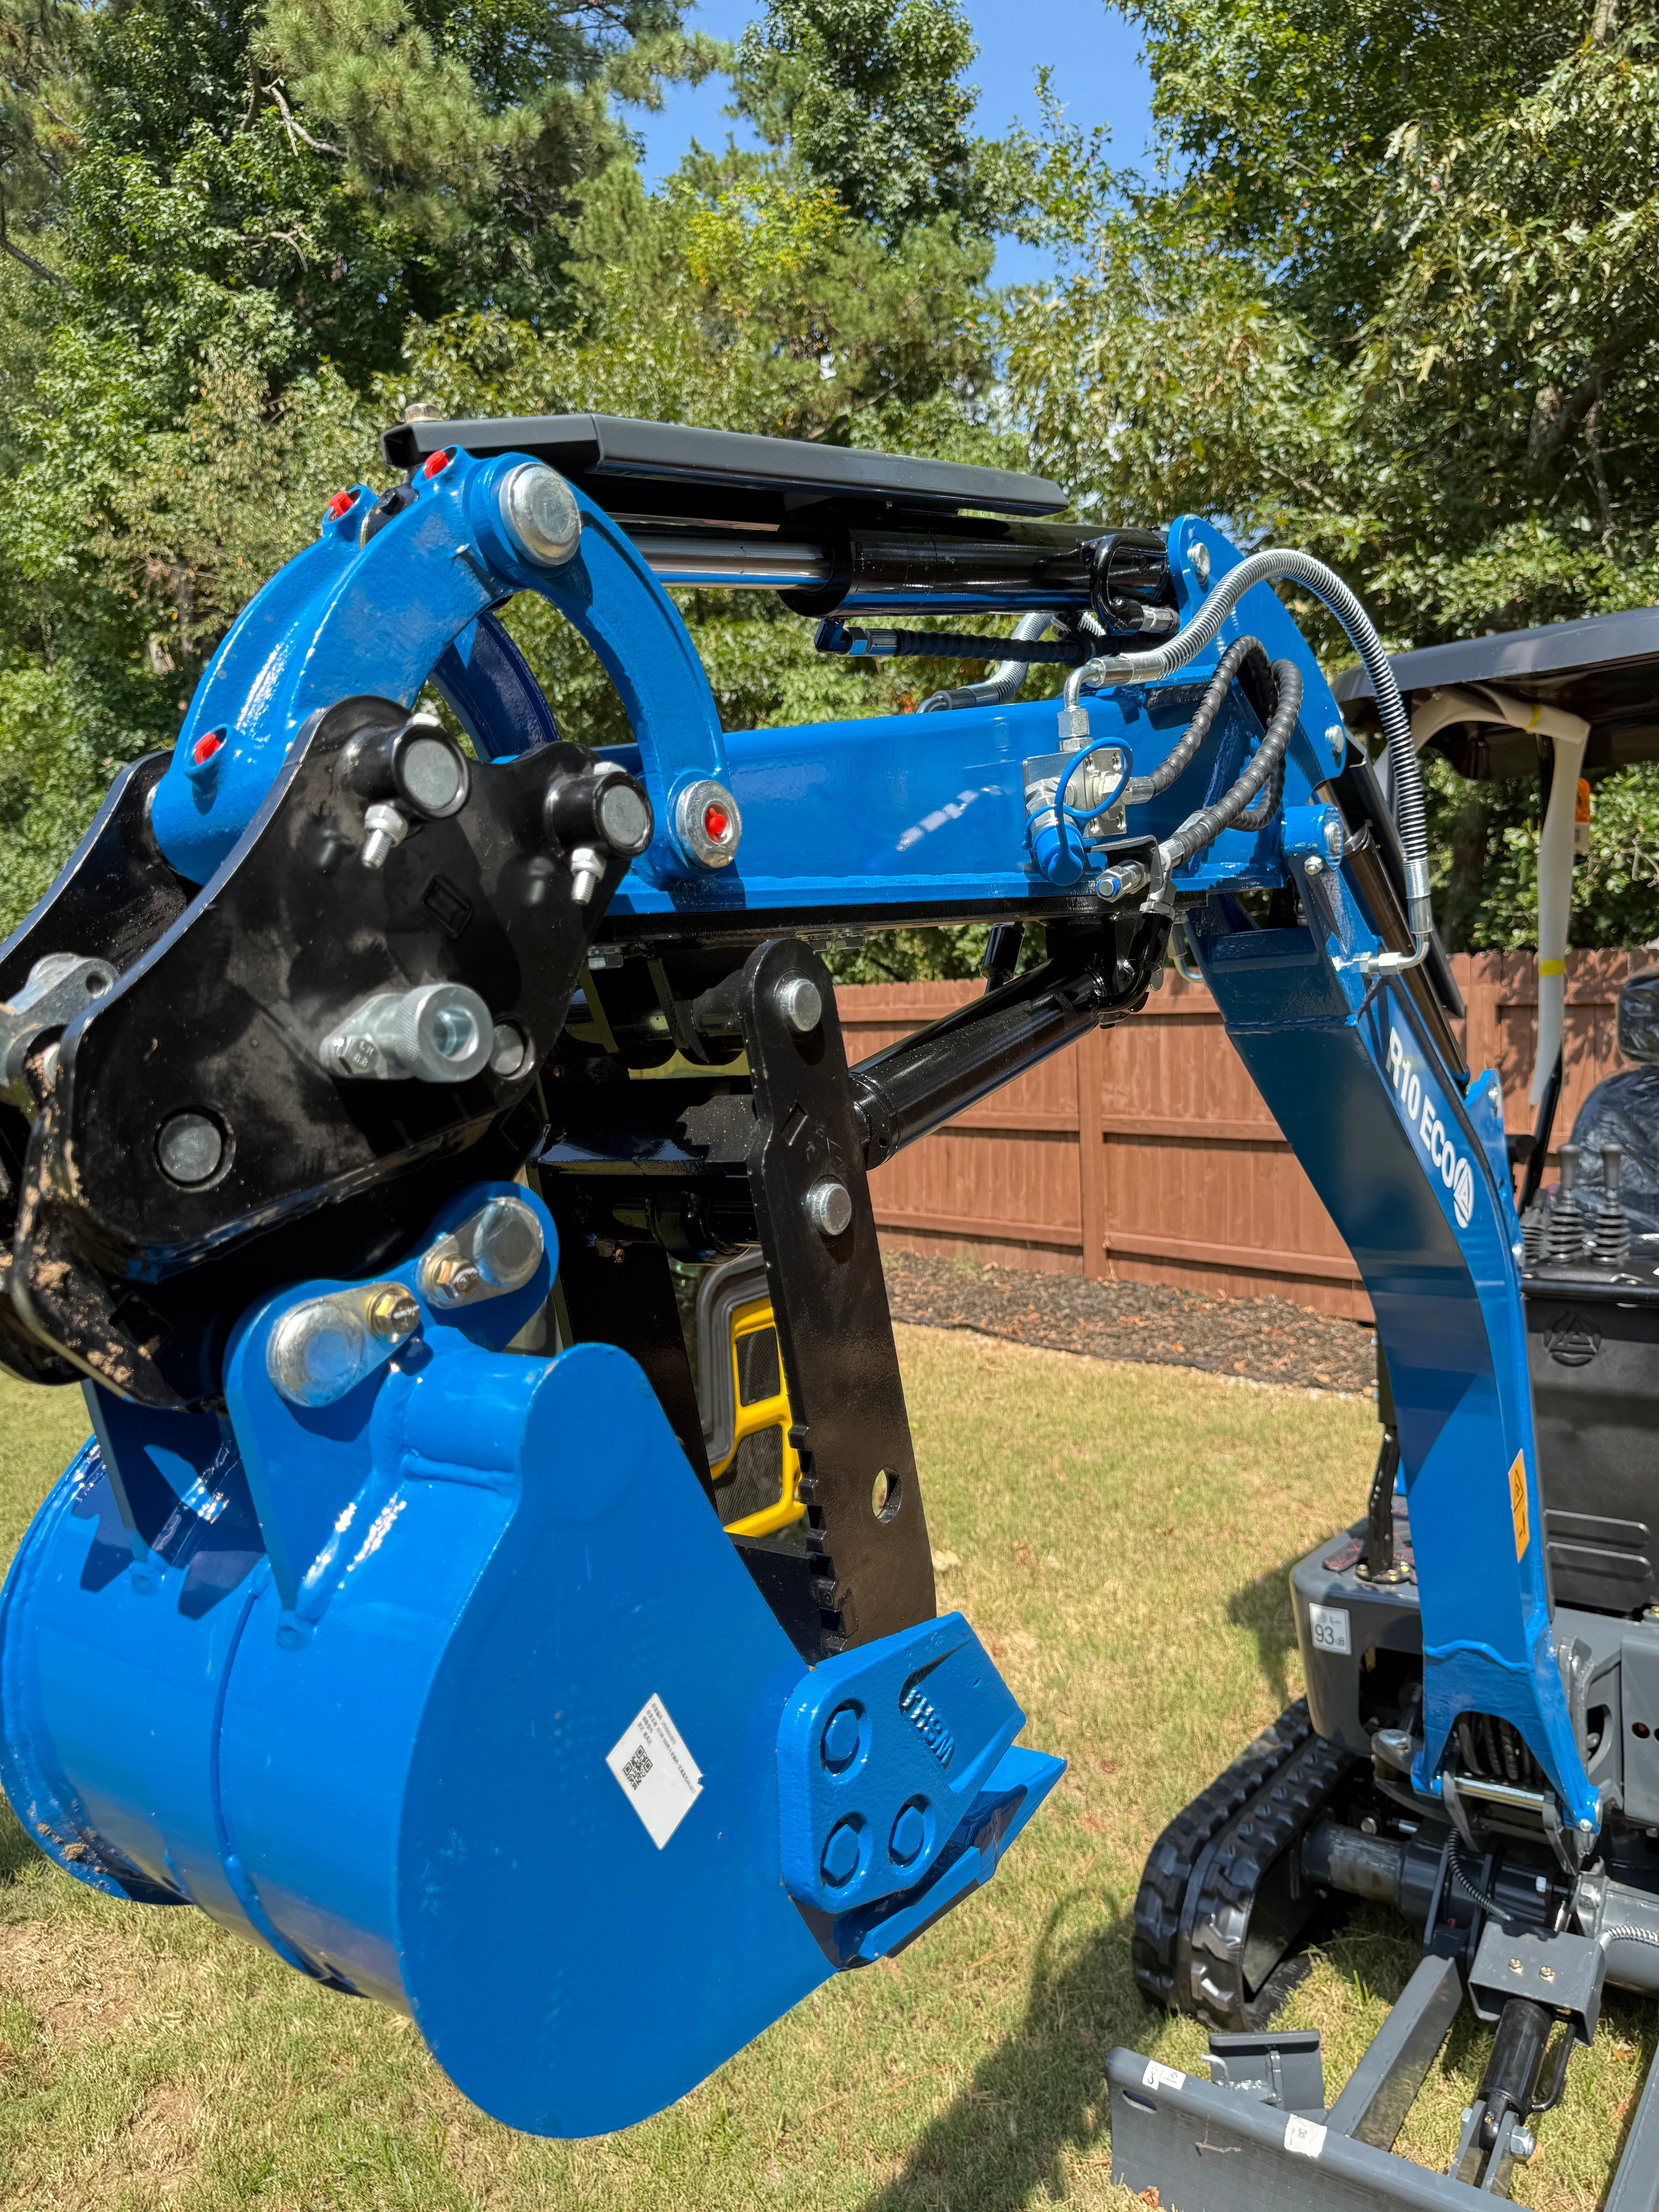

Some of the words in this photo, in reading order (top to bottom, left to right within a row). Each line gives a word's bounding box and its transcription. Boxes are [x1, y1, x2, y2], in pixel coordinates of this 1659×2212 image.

[1386, 1026, 1421, 1121] R10
[1419, 1094, 1457, 1189] ECO
[1315, 1624, 1334, 1644] 93
[1335, 1636, 1345, 1646] dB
